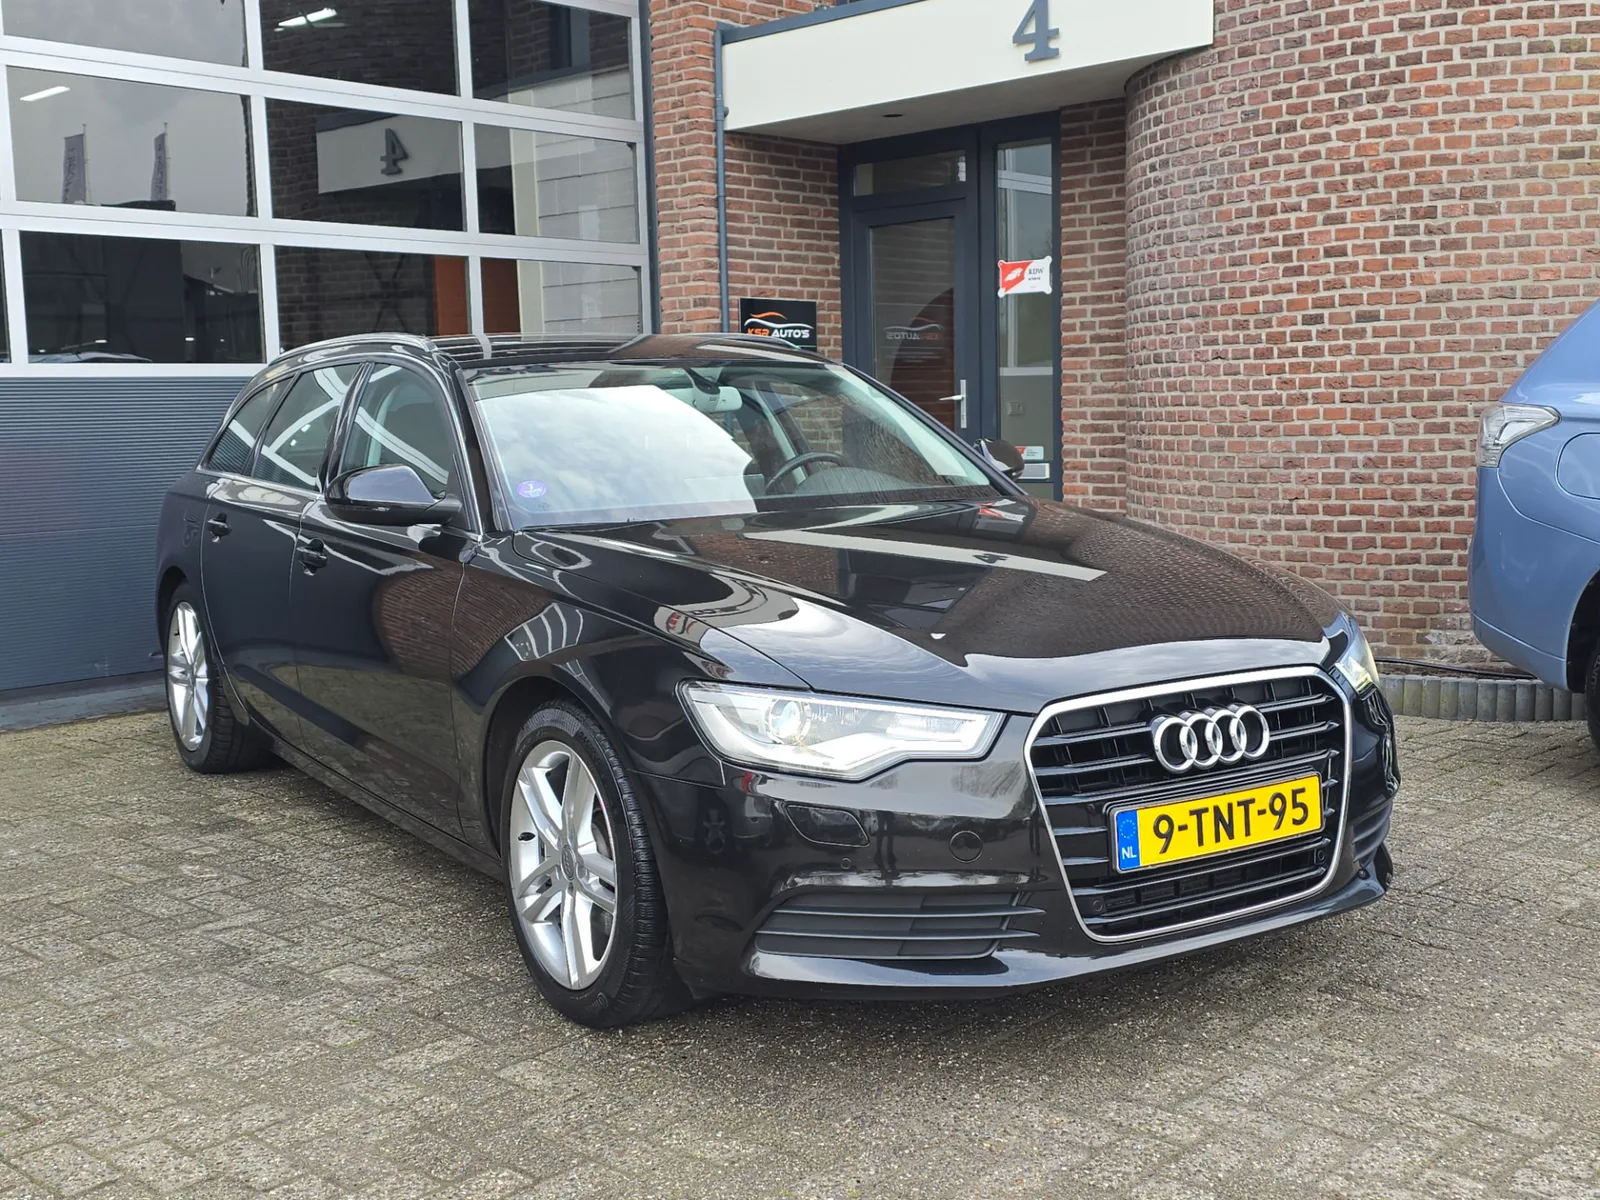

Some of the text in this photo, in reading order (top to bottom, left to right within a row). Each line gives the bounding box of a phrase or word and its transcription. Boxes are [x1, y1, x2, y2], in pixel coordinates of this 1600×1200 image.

[1012, 0, 1059, 62] 4
[1028, 267, 1044, 275] RDW
[771, 329, 810, 339] AUTO'S
[1154, 788, 1309, 854] 9-TNT-95
[1122, 846, 1137, 860] NL
